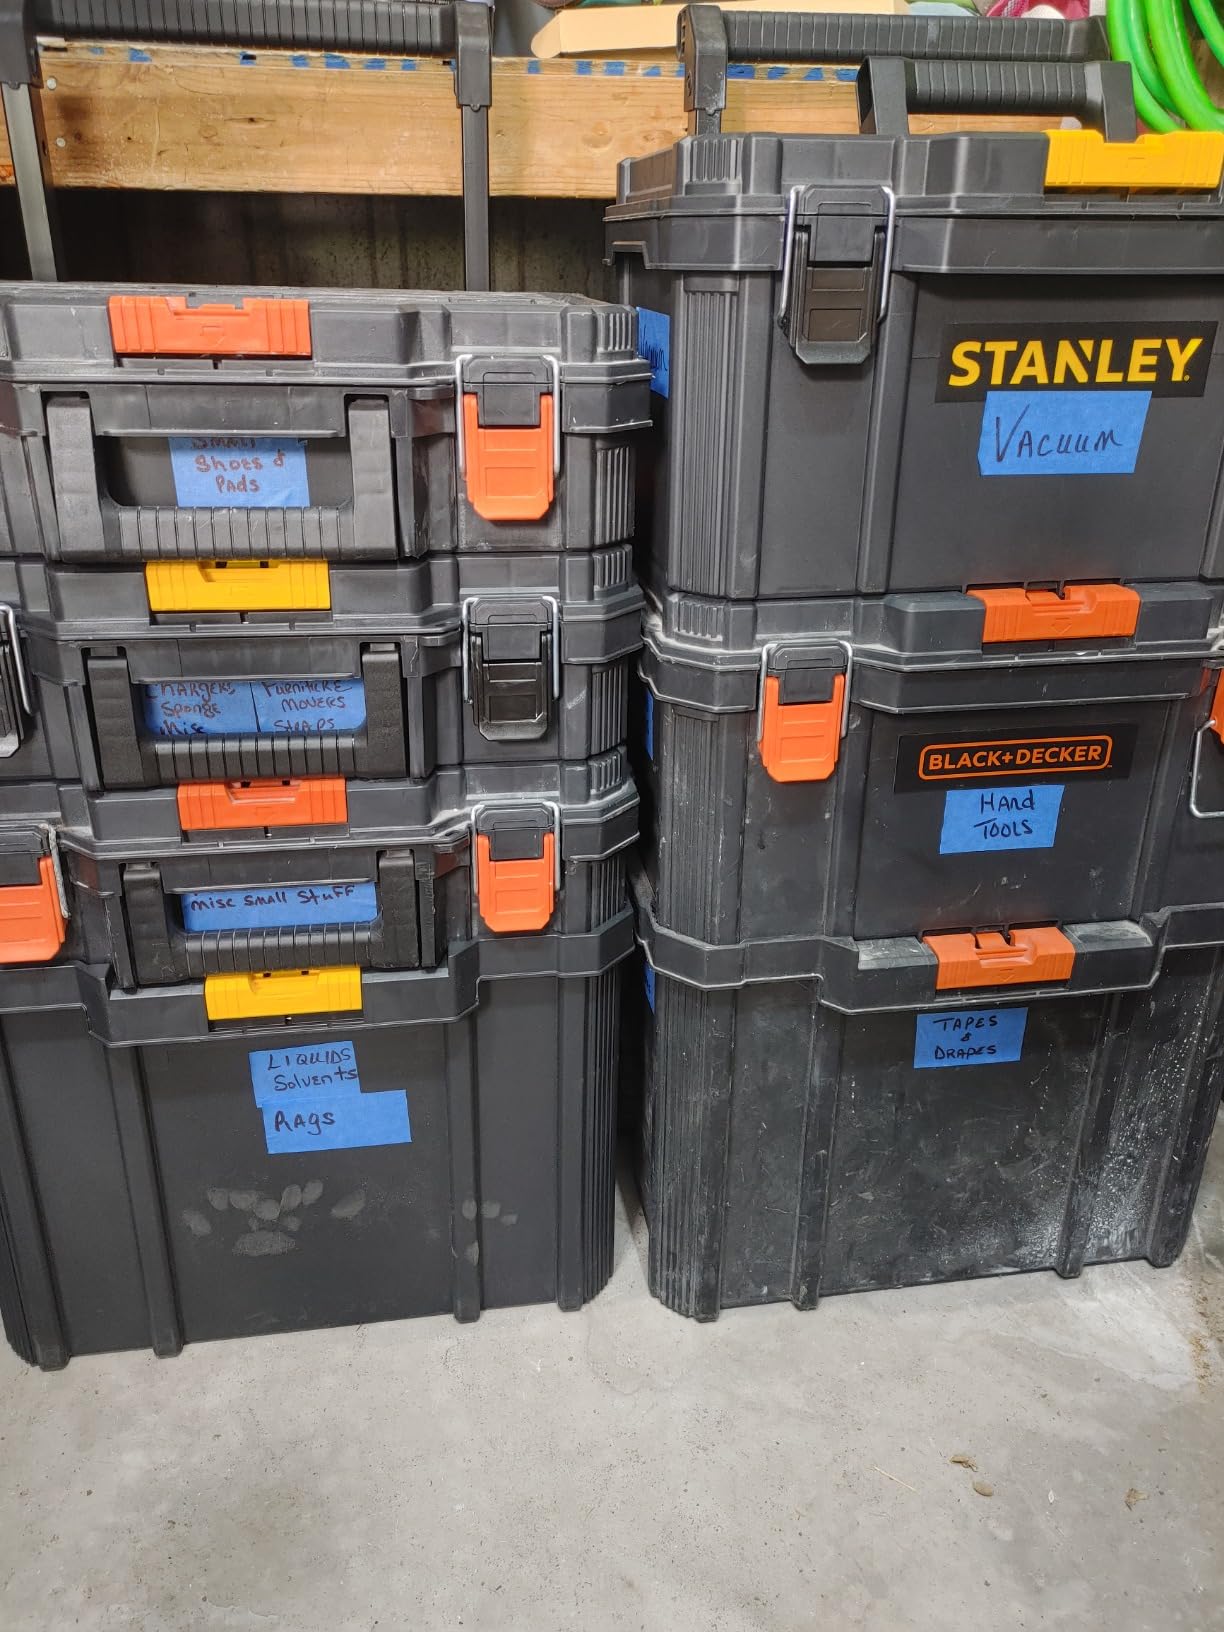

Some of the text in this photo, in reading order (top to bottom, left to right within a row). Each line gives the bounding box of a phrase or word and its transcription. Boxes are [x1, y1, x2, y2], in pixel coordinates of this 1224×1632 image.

[948, 338, 1204, 387] STANLEY
[928, 745, 1102, 771] BLACK+DECKER
[932, 1015, 999, 1031] TAPES
[267, 1047, 351, 1071] LIQUIDS
[934, 1044, 997, 1060] DRAPES
